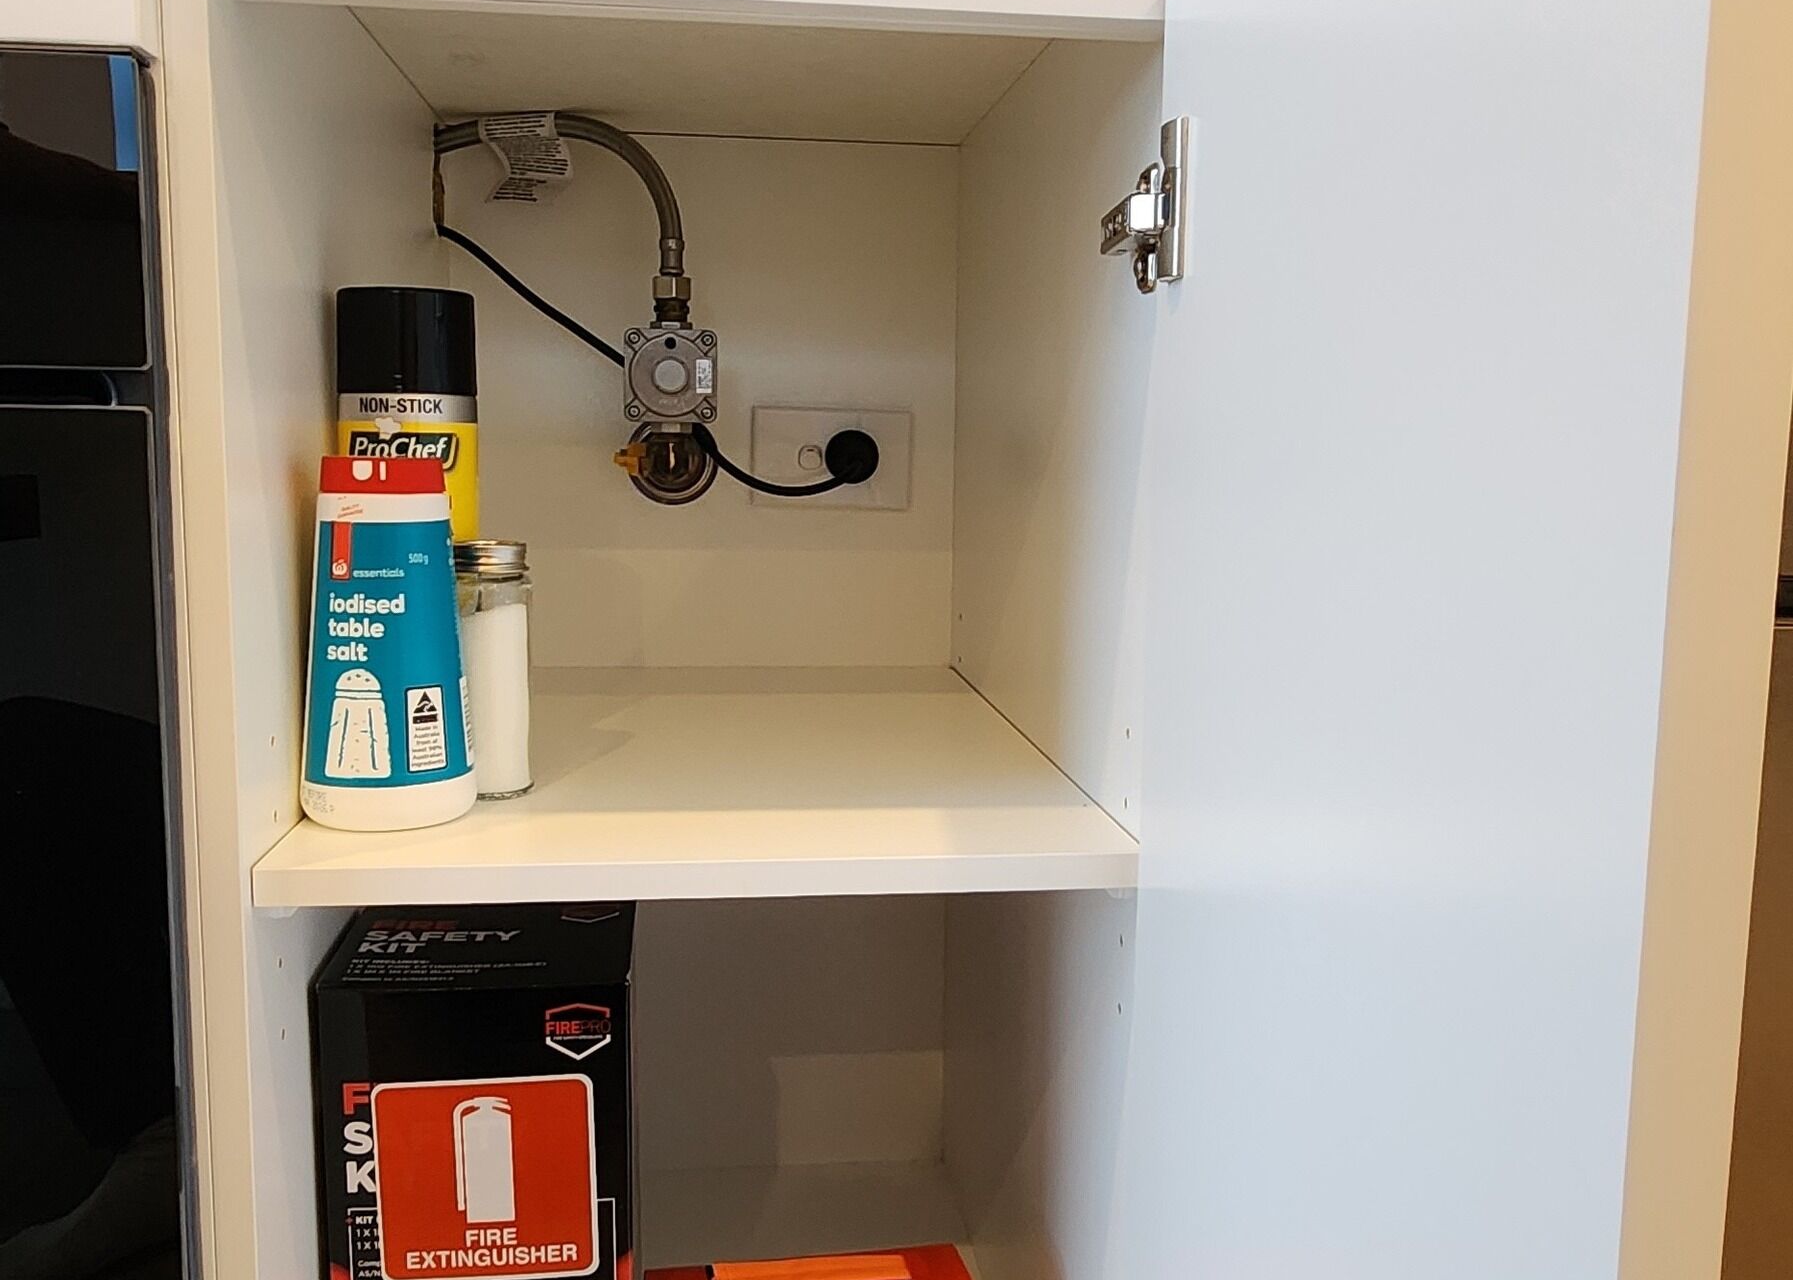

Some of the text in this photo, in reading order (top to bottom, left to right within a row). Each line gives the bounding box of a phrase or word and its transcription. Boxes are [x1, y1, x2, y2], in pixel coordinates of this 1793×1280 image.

[360, 397, 443, 414] NON-STICK
[354, 437, 448, 459] ProChef
[352, 568, 405, 578] essentials
[329, 592, 406, 614] iodised
[327, 617, 385, 638] table
[326, 642, 369, 662] salt
[371, 921, 457, 930] FIRE
[364, 930, 521, 942] SAFETY
[357, 942, 427, 953] KIT
[545, 1020, 611, 1035] FIREPRO
[355, 1216, 373, 1224] KIT
[465, 1227, 518, 1247] FIRE
[406, 1244, 578, 1269] EXTINGUISHER
[359, 1270, 381, 1278] AS/N
